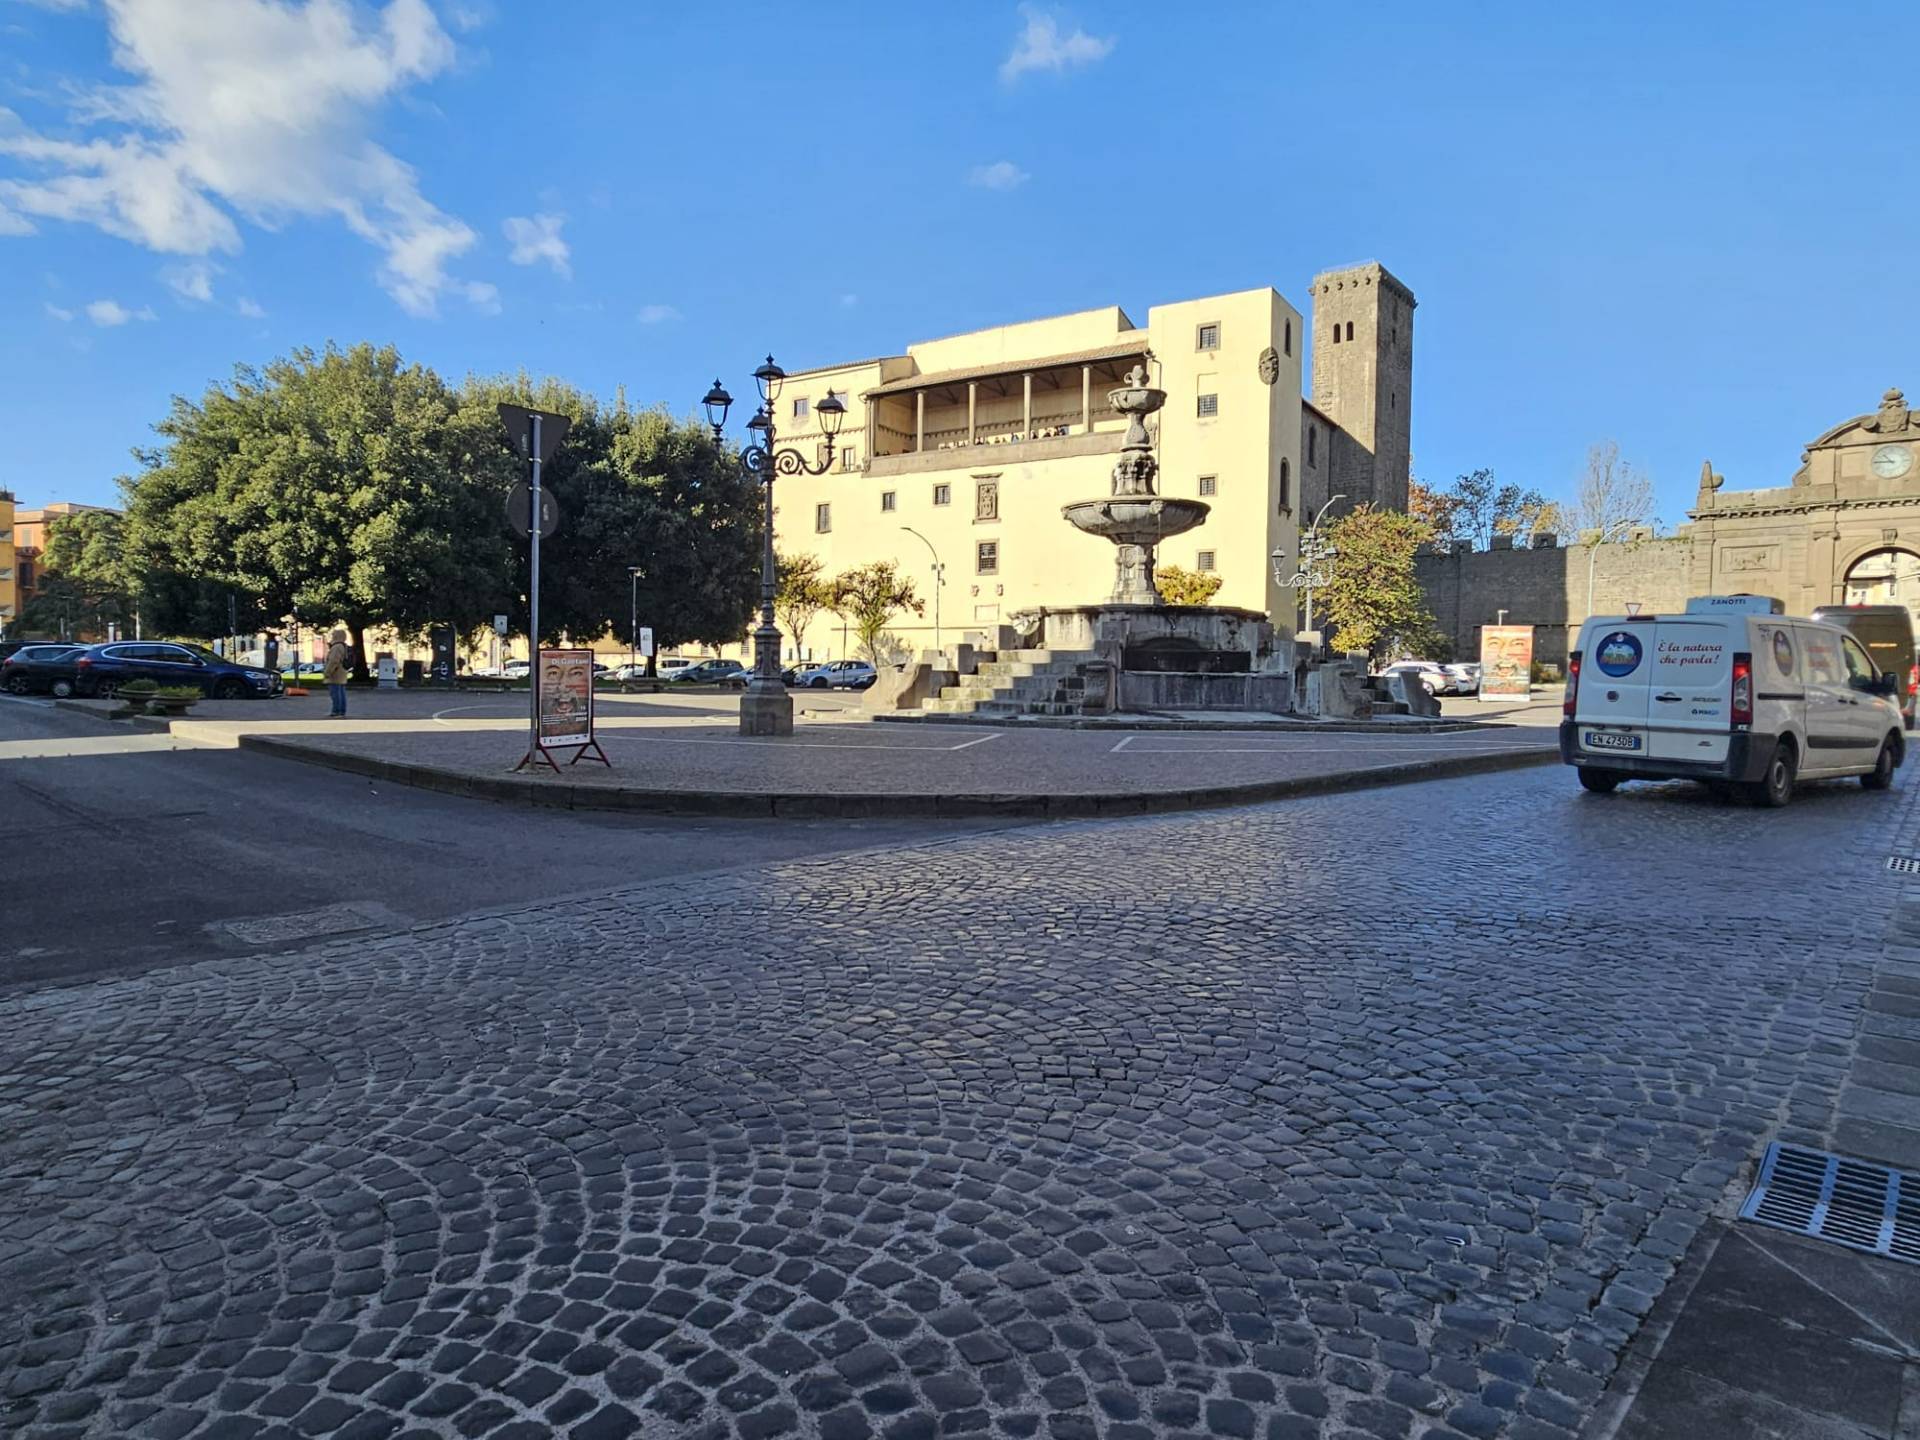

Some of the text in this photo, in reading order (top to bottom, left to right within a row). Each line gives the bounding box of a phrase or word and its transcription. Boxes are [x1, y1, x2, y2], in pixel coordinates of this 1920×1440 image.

[1668, 642, 1680, 652] la
[1682, 644, 1722, 652] natura
[1660, 655, 1677, 664] che
